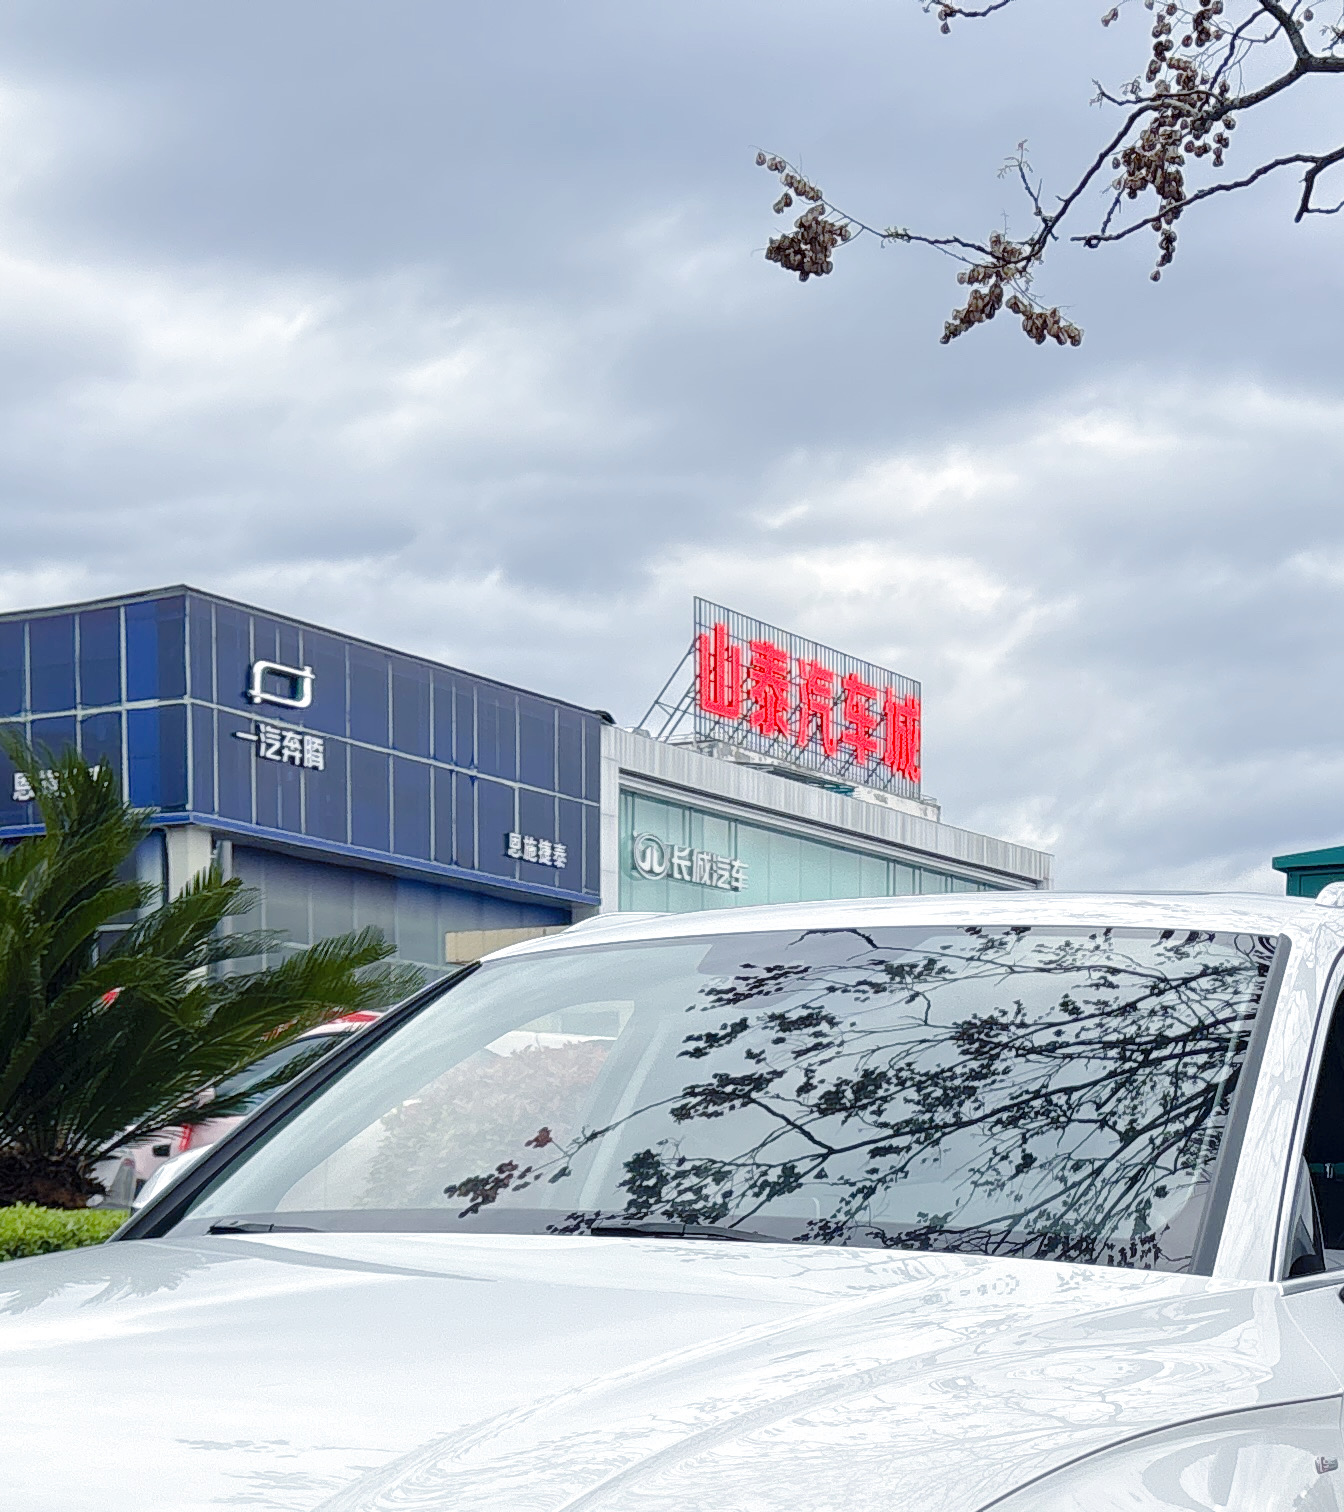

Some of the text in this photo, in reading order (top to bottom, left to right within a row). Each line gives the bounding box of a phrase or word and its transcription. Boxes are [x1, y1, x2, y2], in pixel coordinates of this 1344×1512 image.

[699, 621, 922, 784] 山泰汽车城
[234, 723, 325, 771] 一汽奔腾
[671, 845, 749, 892] 长城汽车
